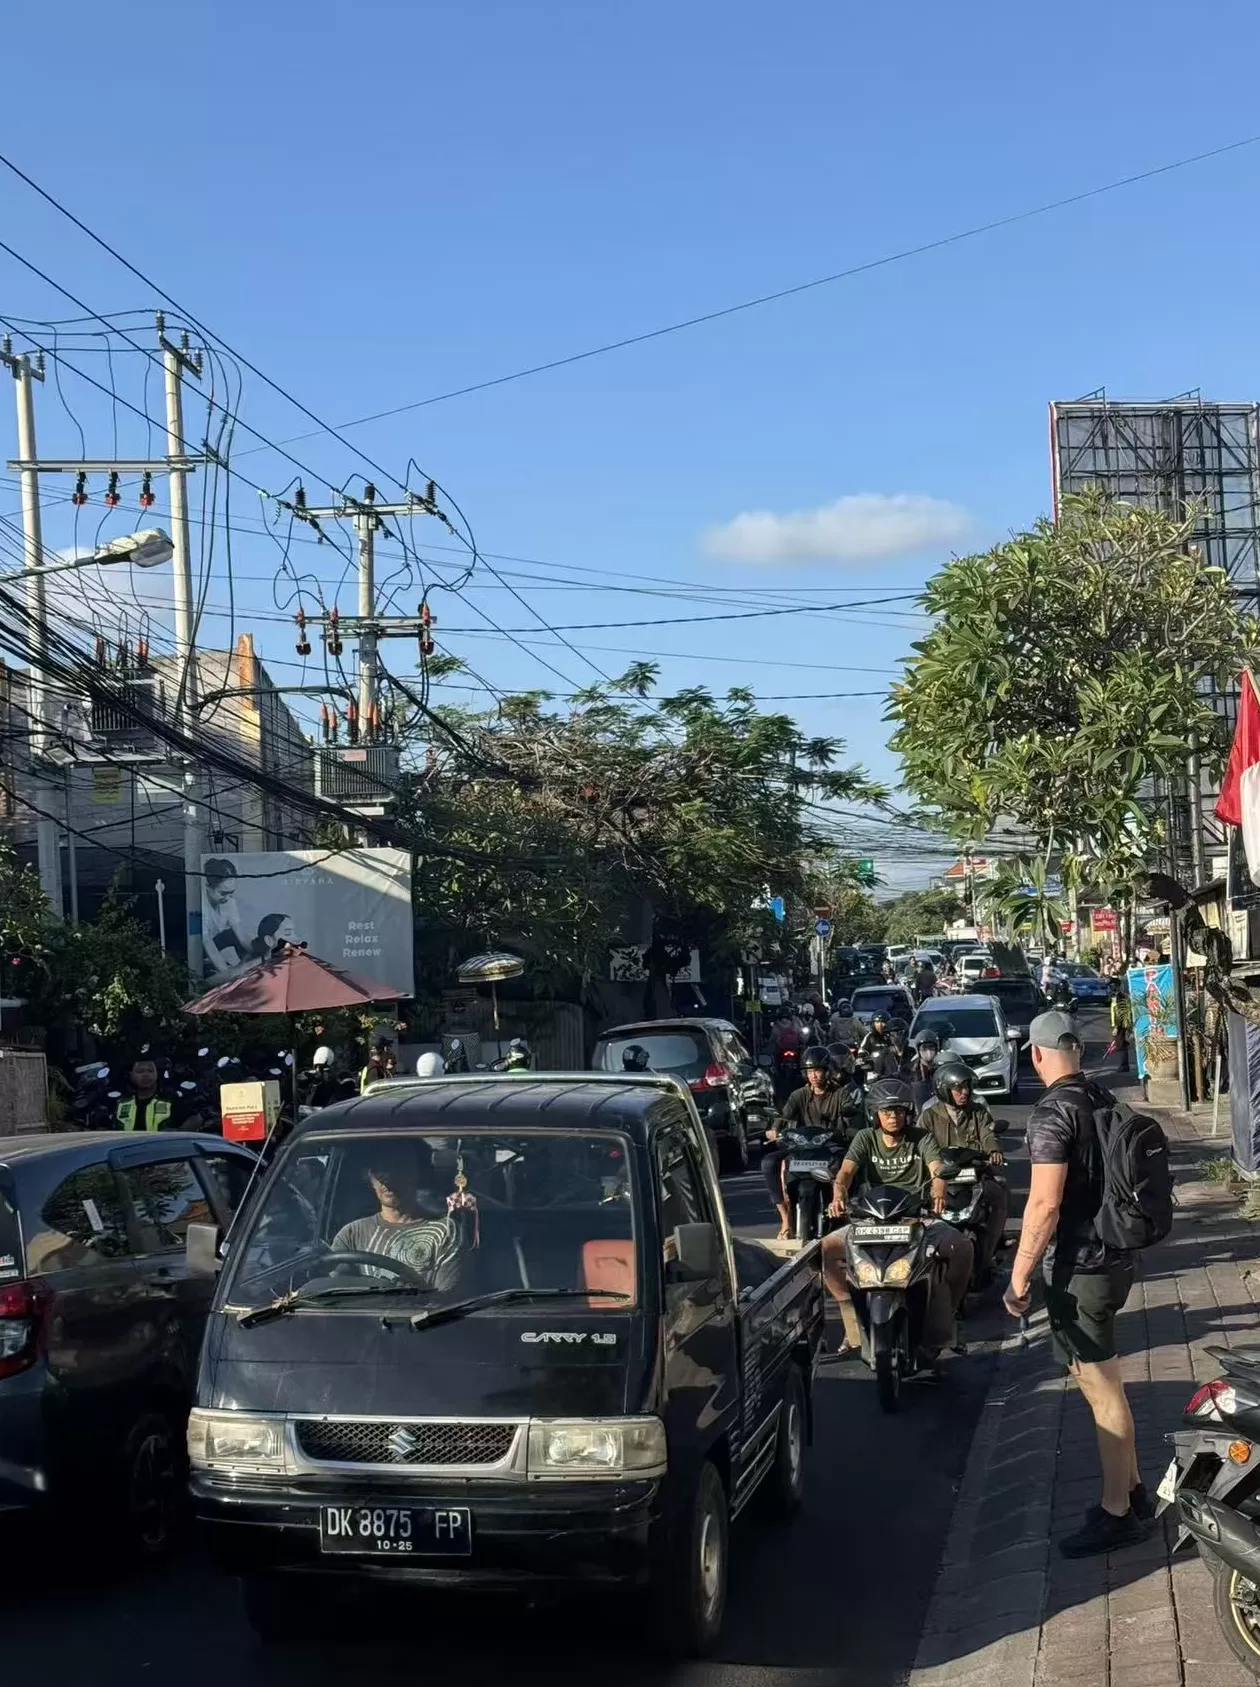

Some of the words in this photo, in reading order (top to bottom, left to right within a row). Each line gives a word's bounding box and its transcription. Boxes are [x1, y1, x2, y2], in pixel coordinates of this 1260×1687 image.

[348, 920, 375, 931] Rest
[345, 934, 379, 945] Relax
[342, 947, 382, 958] Renew
[521, 1332, 587, 1343] CARRY
[591, 1333, 617, 1344] 1.5
[327, 1508, 353, 1536] DK
[359, 1509, 412, 1538] 8875
[435, 1512, 462, 1539] FP
